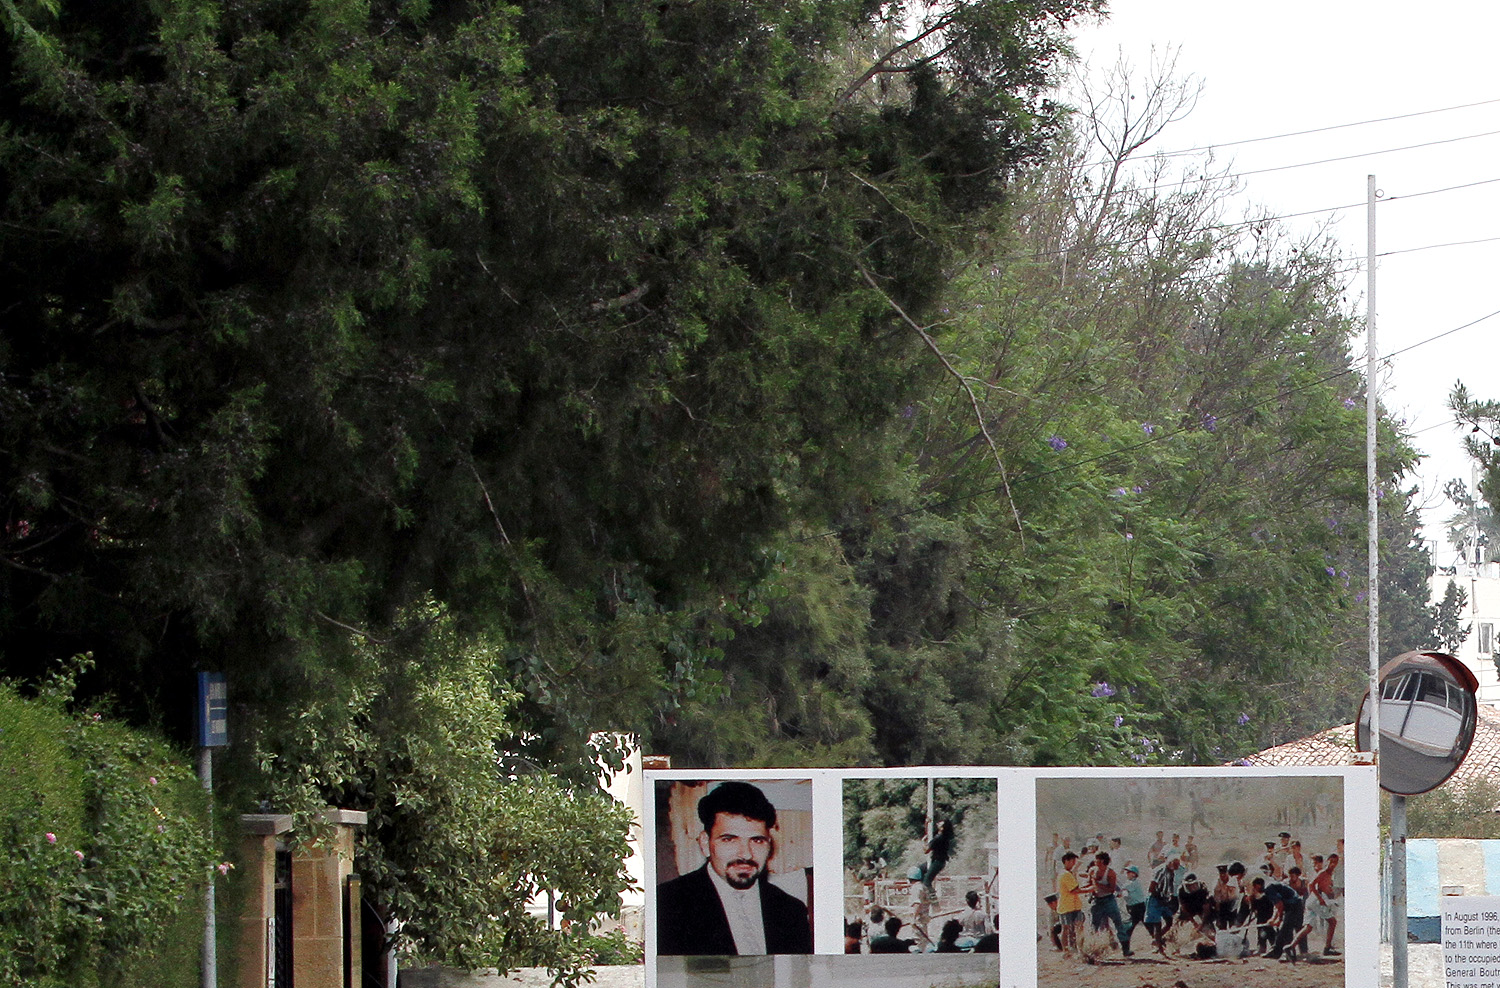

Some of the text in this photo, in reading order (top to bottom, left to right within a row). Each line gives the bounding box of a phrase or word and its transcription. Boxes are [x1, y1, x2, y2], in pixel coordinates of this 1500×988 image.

[1444, 912, 1452, 921] In
[1453, 912, 1478, 923] August
[1445, 968, 1476, 977] General
